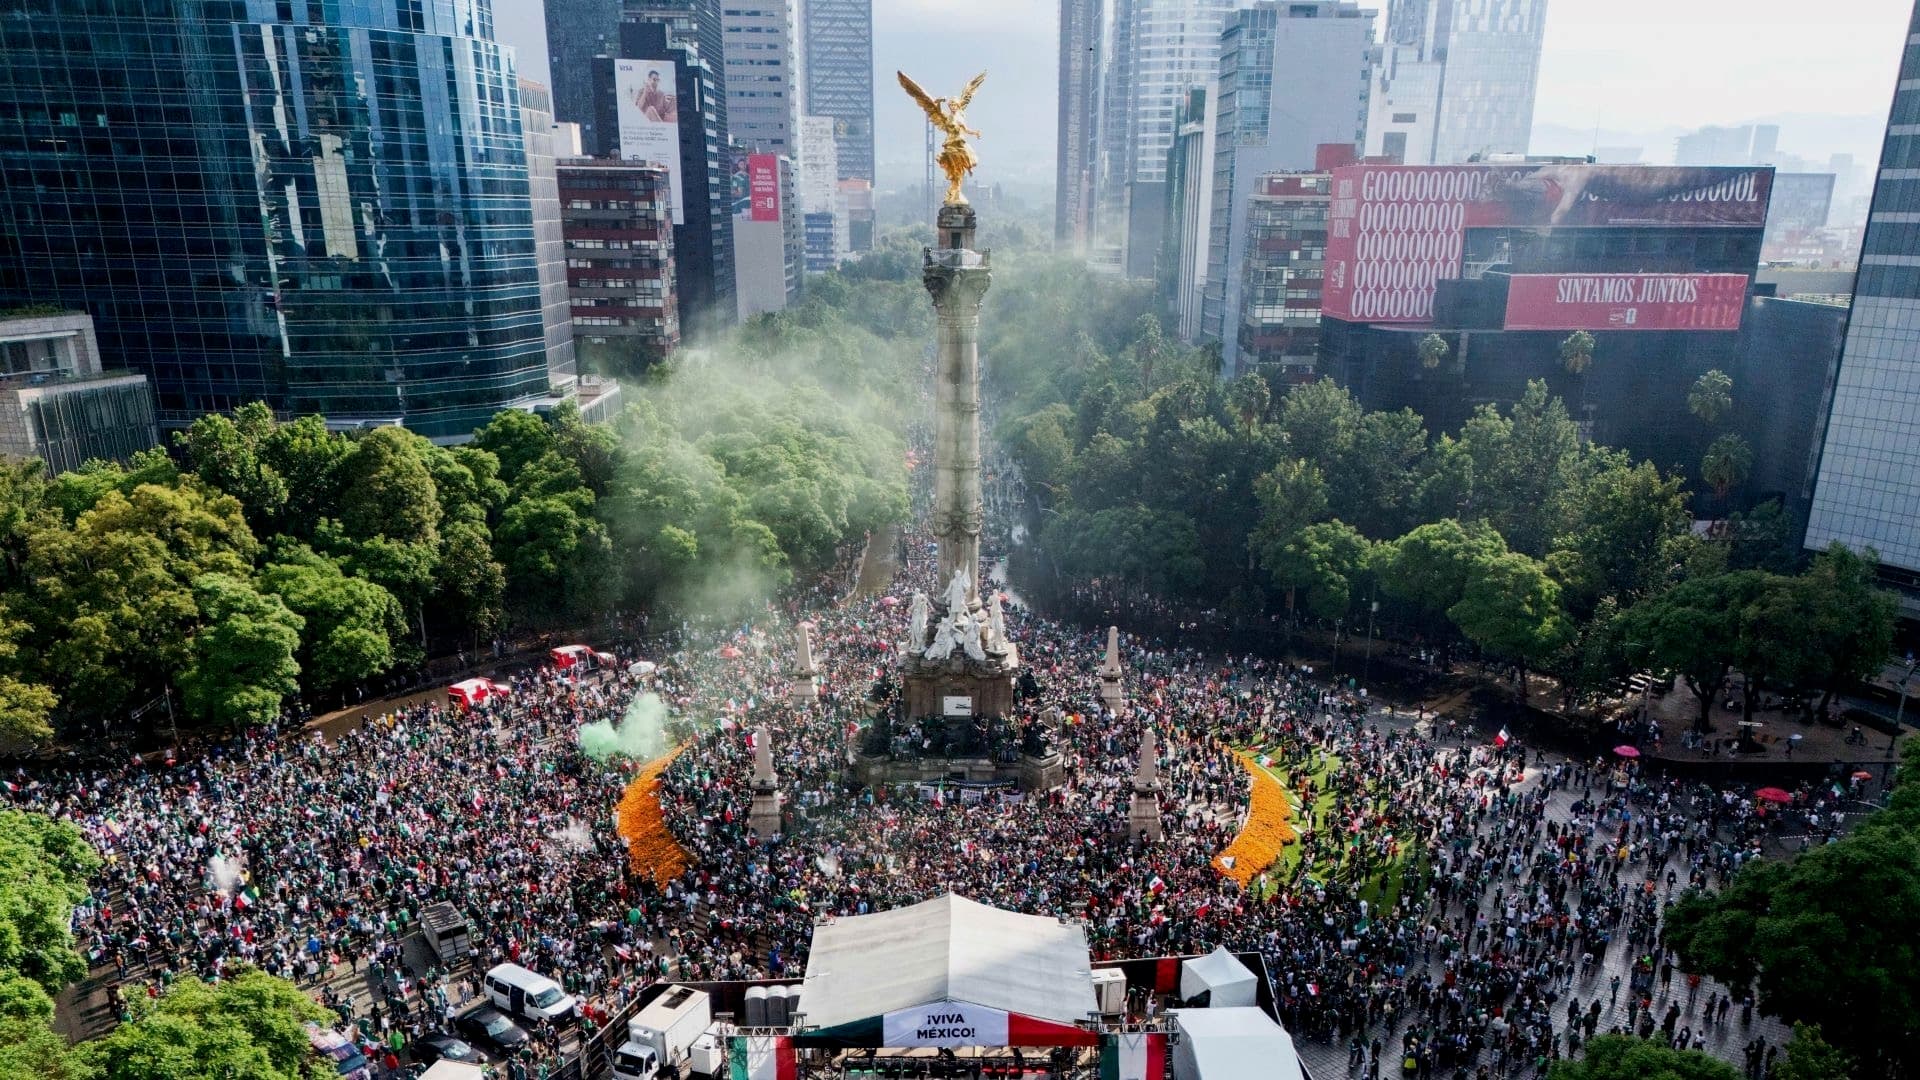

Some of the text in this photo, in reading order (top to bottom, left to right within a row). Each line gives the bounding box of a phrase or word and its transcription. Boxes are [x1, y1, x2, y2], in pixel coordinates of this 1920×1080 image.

[1556, 278, 1635, 303] SINTAMOS
[1636, 278, 1699, 303] JUNTOS
[927, 1014, 965, 1025] ¡VIVA
[917, 1027, 975, 1039] MÉXICO!
